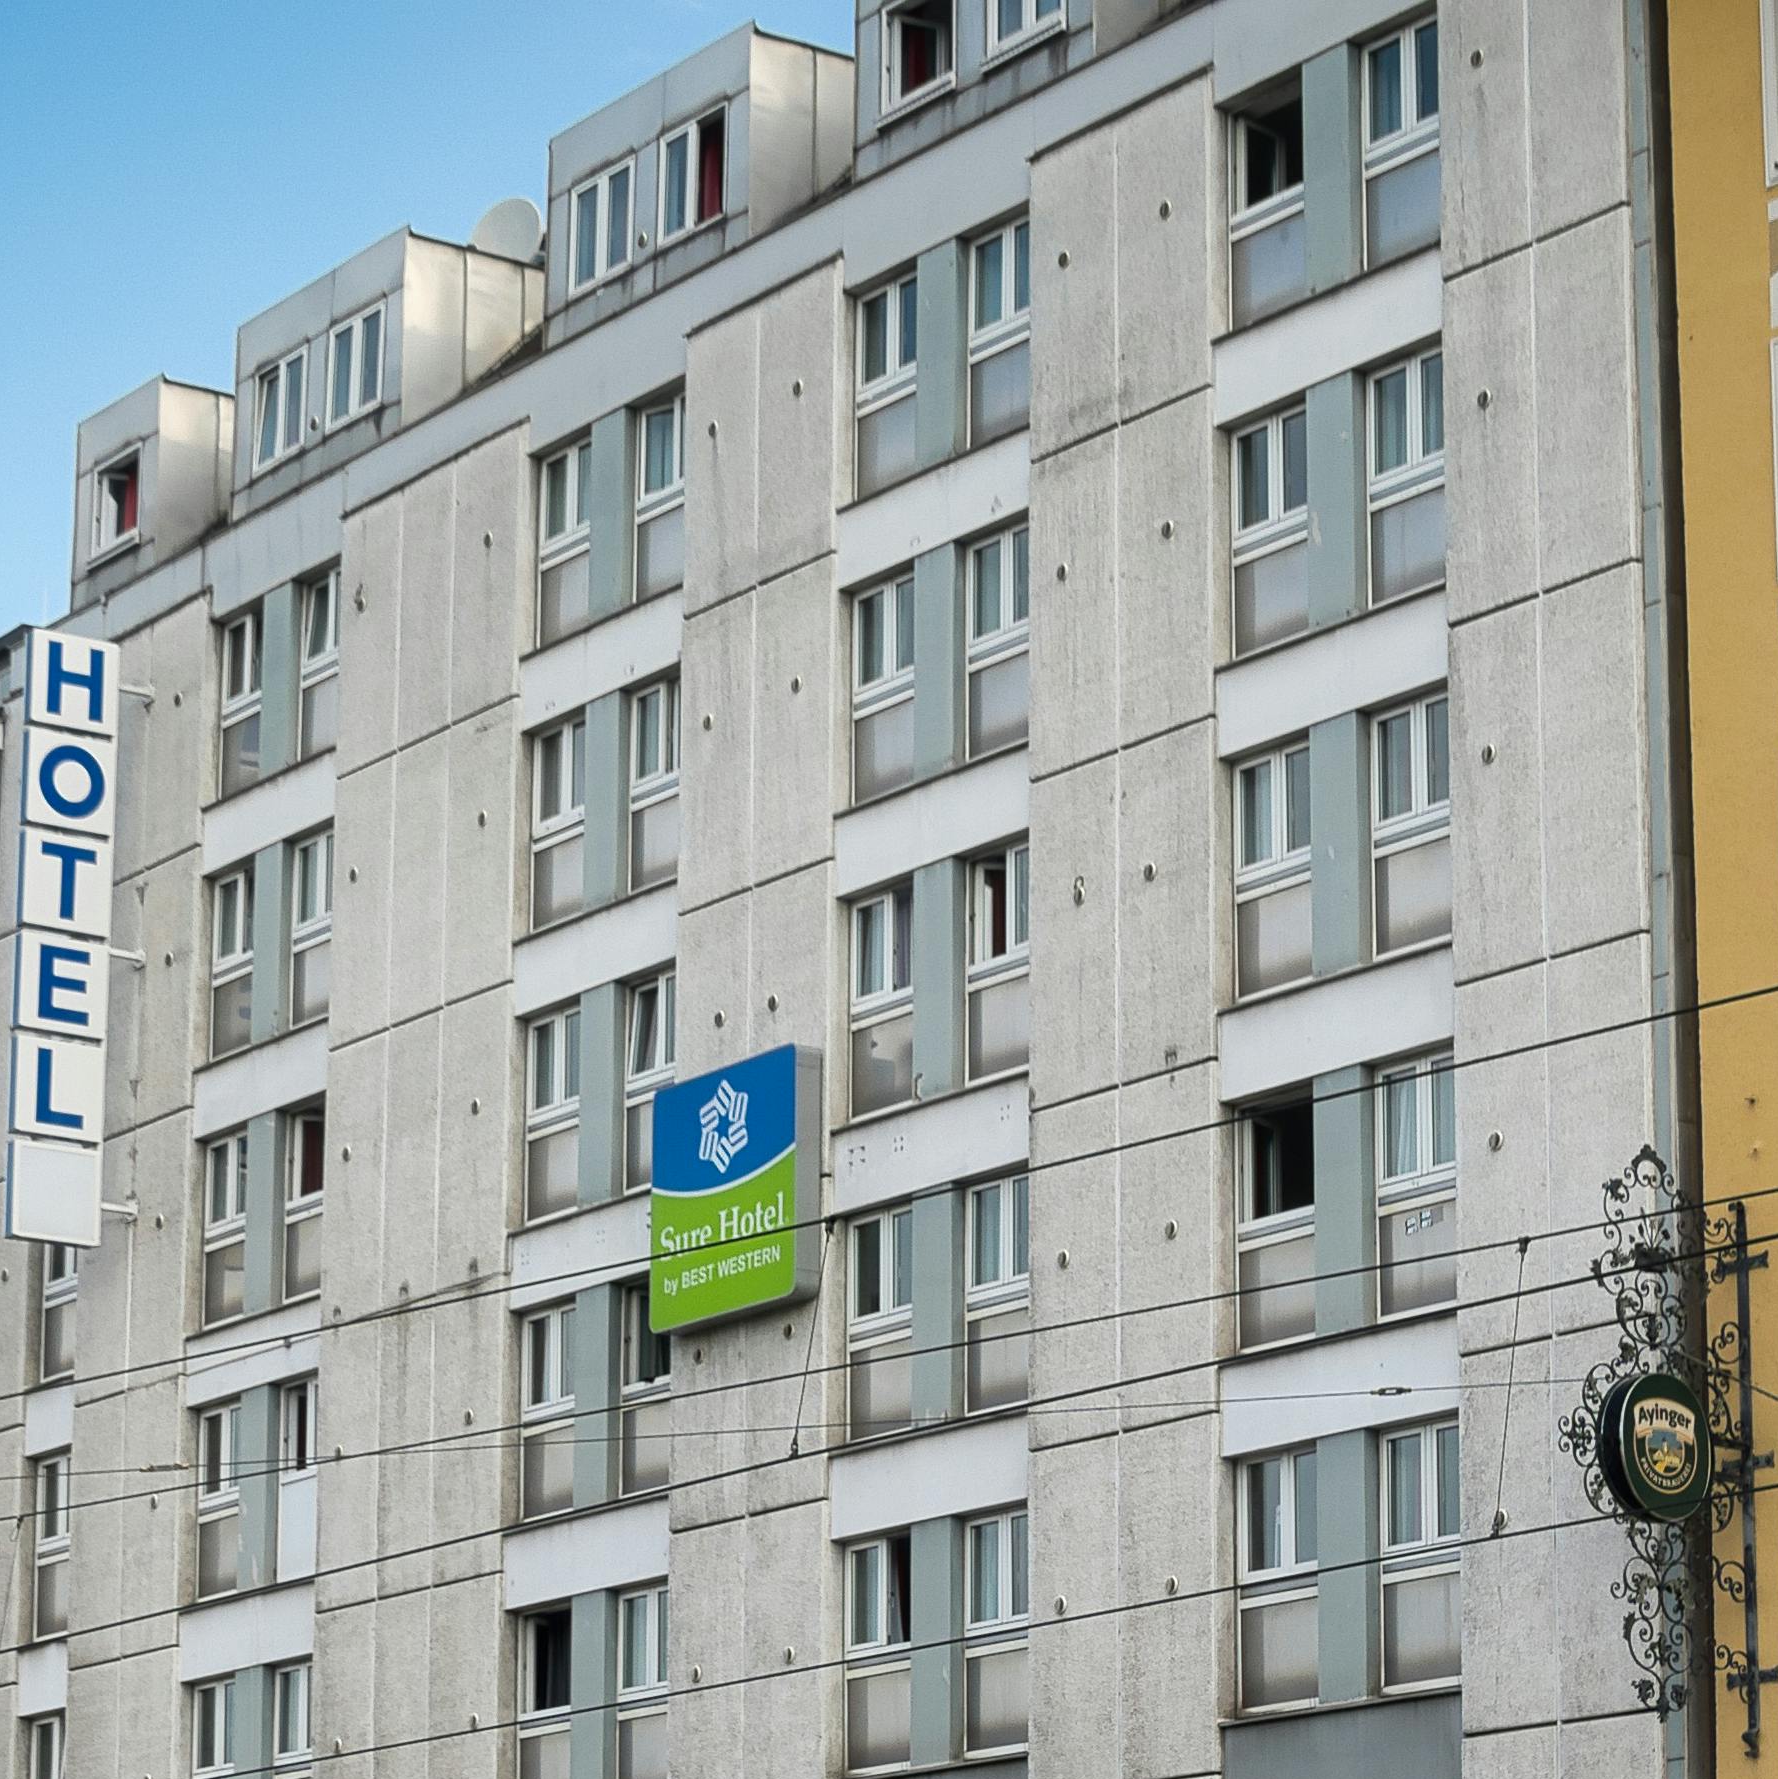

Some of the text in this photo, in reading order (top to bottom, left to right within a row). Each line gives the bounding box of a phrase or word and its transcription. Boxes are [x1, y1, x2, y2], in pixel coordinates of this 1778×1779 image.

[35, 641, 105, 1130] HOTEL
[659, 1190, 786, 1261] Sure Hotel
[663, 1244, 782, 1296] by BEST WESTERN
[1638, 1403, 1692, 1429] Ayinger
